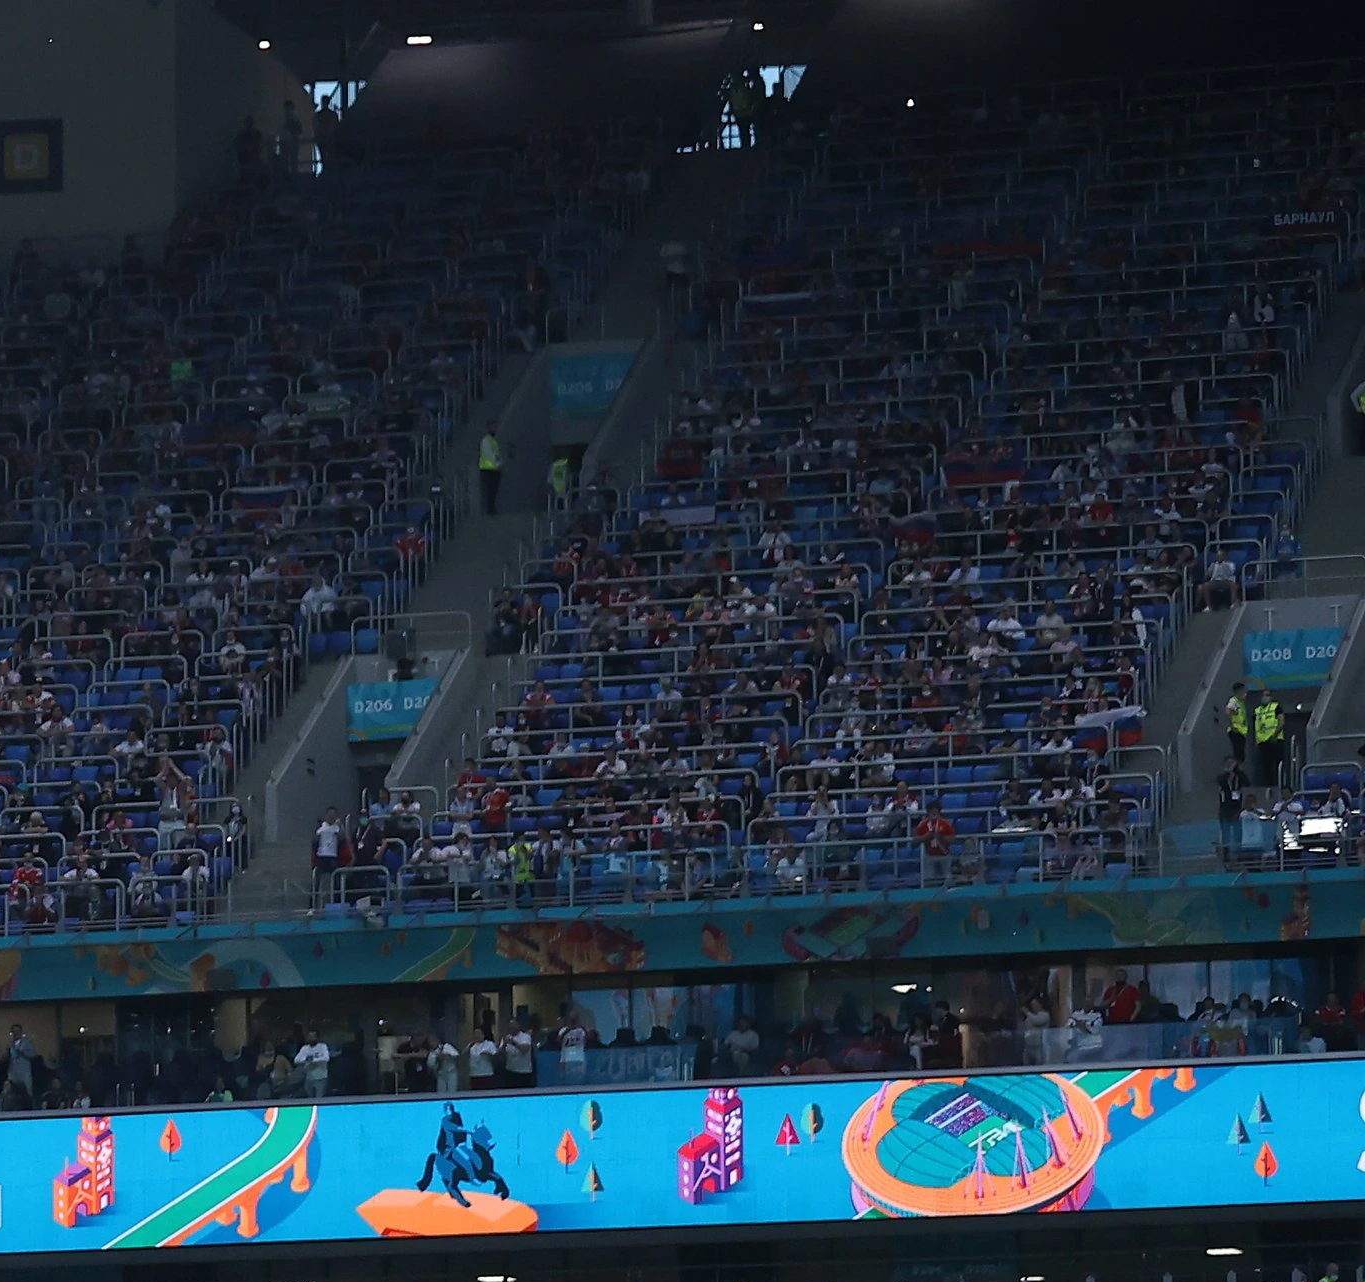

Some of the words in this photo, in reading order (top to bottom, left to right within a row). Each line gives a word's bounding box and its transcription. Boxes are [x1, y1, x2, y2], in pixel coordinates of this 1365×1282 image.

[1274, 211, 1335, 226] БАРНАУЛ
[1250, 648, 1292, 662] D208
[1305, 644, 1338, 659] D20
[354, 698, 393, 714] D206
